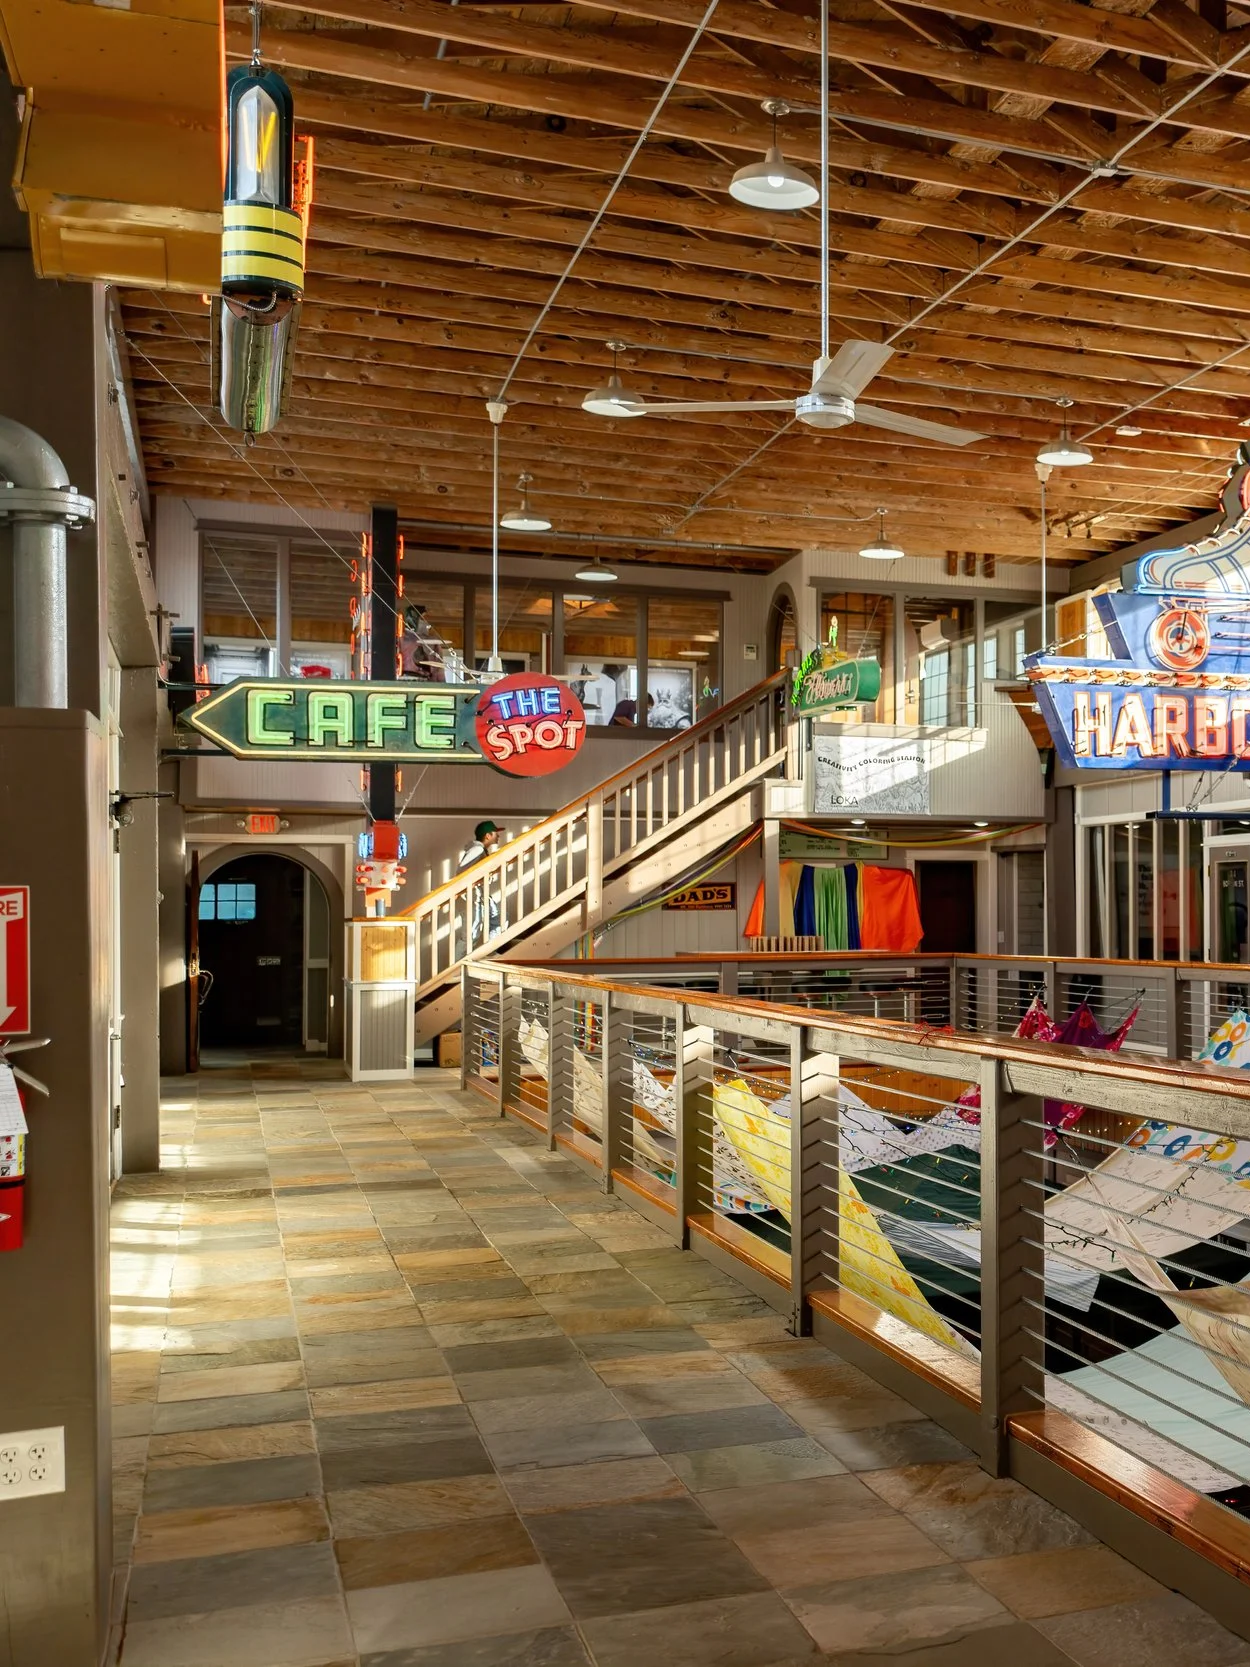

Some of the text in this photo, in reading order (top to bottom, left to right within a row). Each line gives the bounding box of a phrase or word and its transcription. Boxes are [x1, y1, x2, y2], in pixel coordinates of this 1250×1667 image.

[491, 686, 561, 720] THE
[247, 688, 456, 750] CAFE
[485, 719, 585, 762] SPOT
[817, 755, 926, 772] CREATIVITY COLORING STATION
[830, 794, 859, 806] LOKA
[251, 815, 275, 833] EXIT
